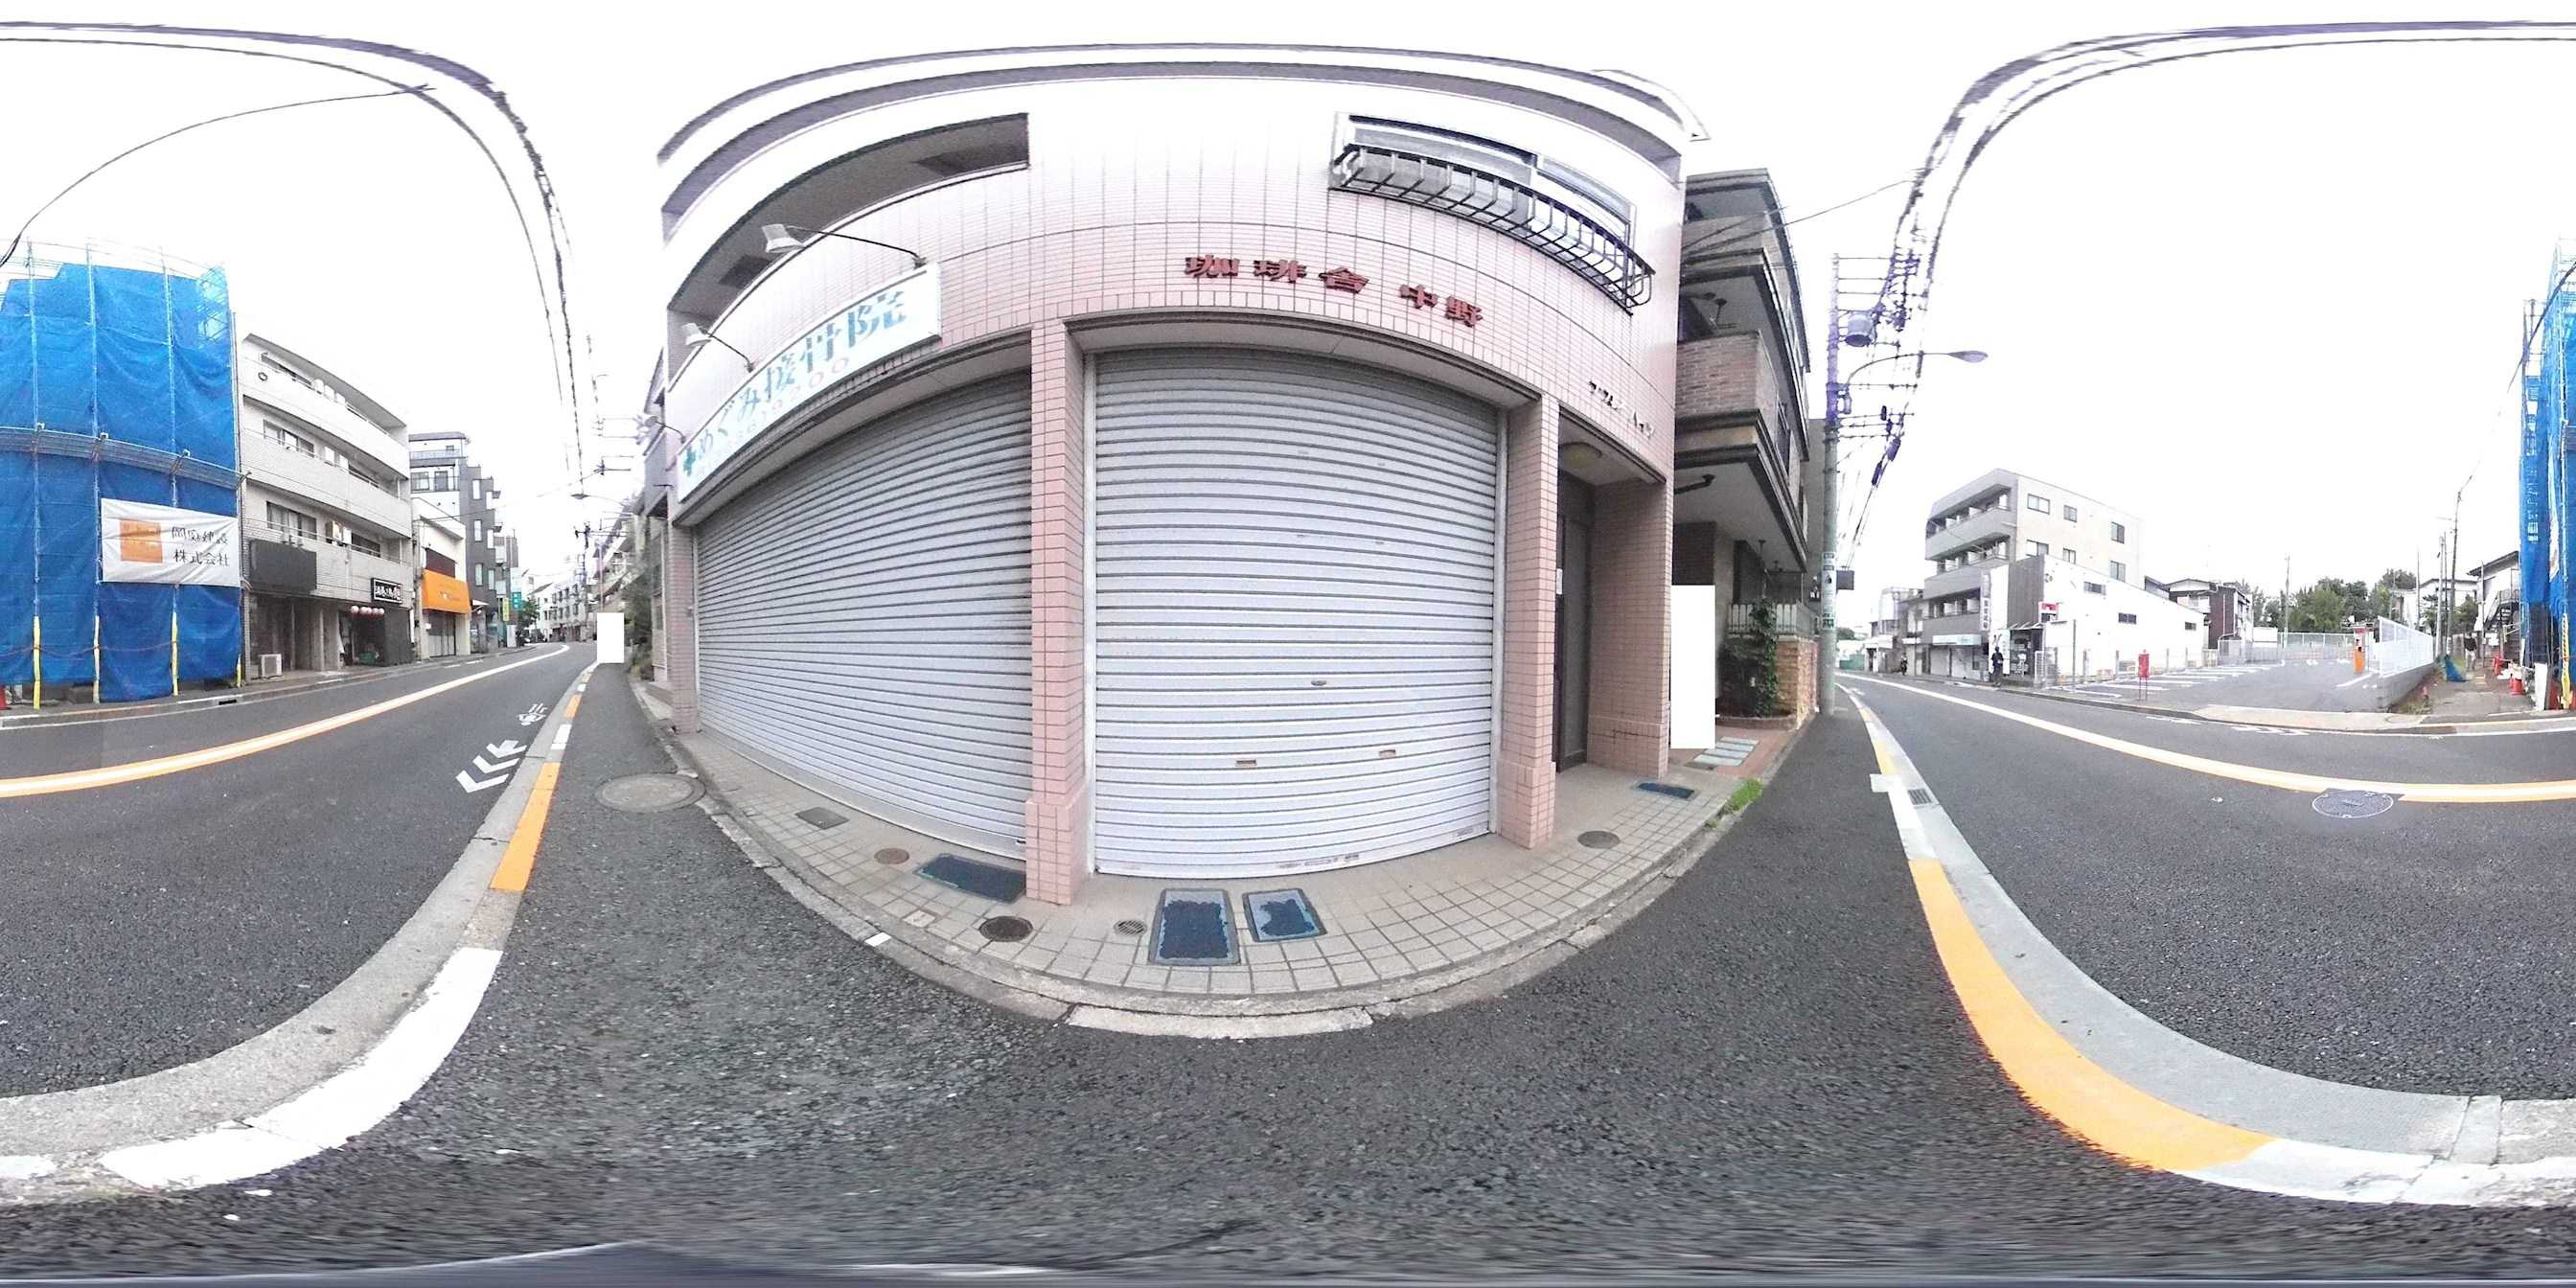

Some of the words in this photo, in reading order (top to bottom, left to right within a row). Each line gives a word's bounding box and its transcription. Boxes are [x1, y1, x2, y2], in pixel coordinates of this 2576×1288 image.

[1399, 284, 1484, 328] 中野
[174, 549, 228, 566] 株式会社
